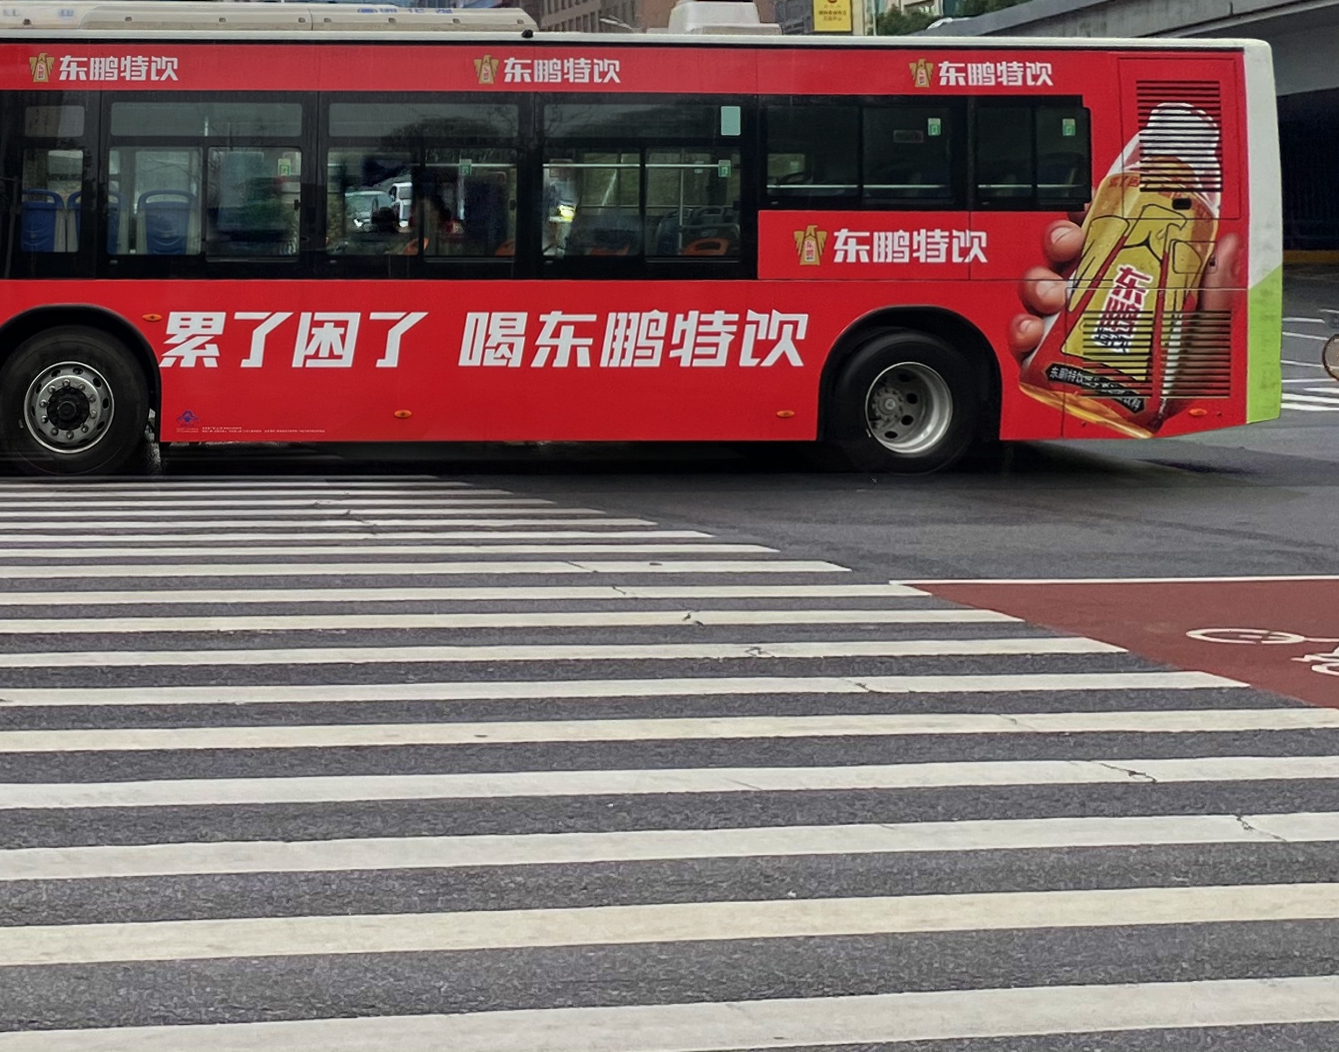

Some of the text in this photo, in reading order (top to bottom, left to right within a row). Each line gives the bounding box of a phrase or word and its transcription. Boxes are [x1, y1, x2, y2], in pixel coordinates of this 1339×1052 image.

[59, 55, 179, 82] 东鹏特饮
[503, 57, 621, 84] 东鹏特饮
[938, 61, 1054, 87] 东鹏特饮
[833, 228, 989, 264] 东鹏特饮
[160, 309, 809, 368] 累了困了 喝东鹏特饮
